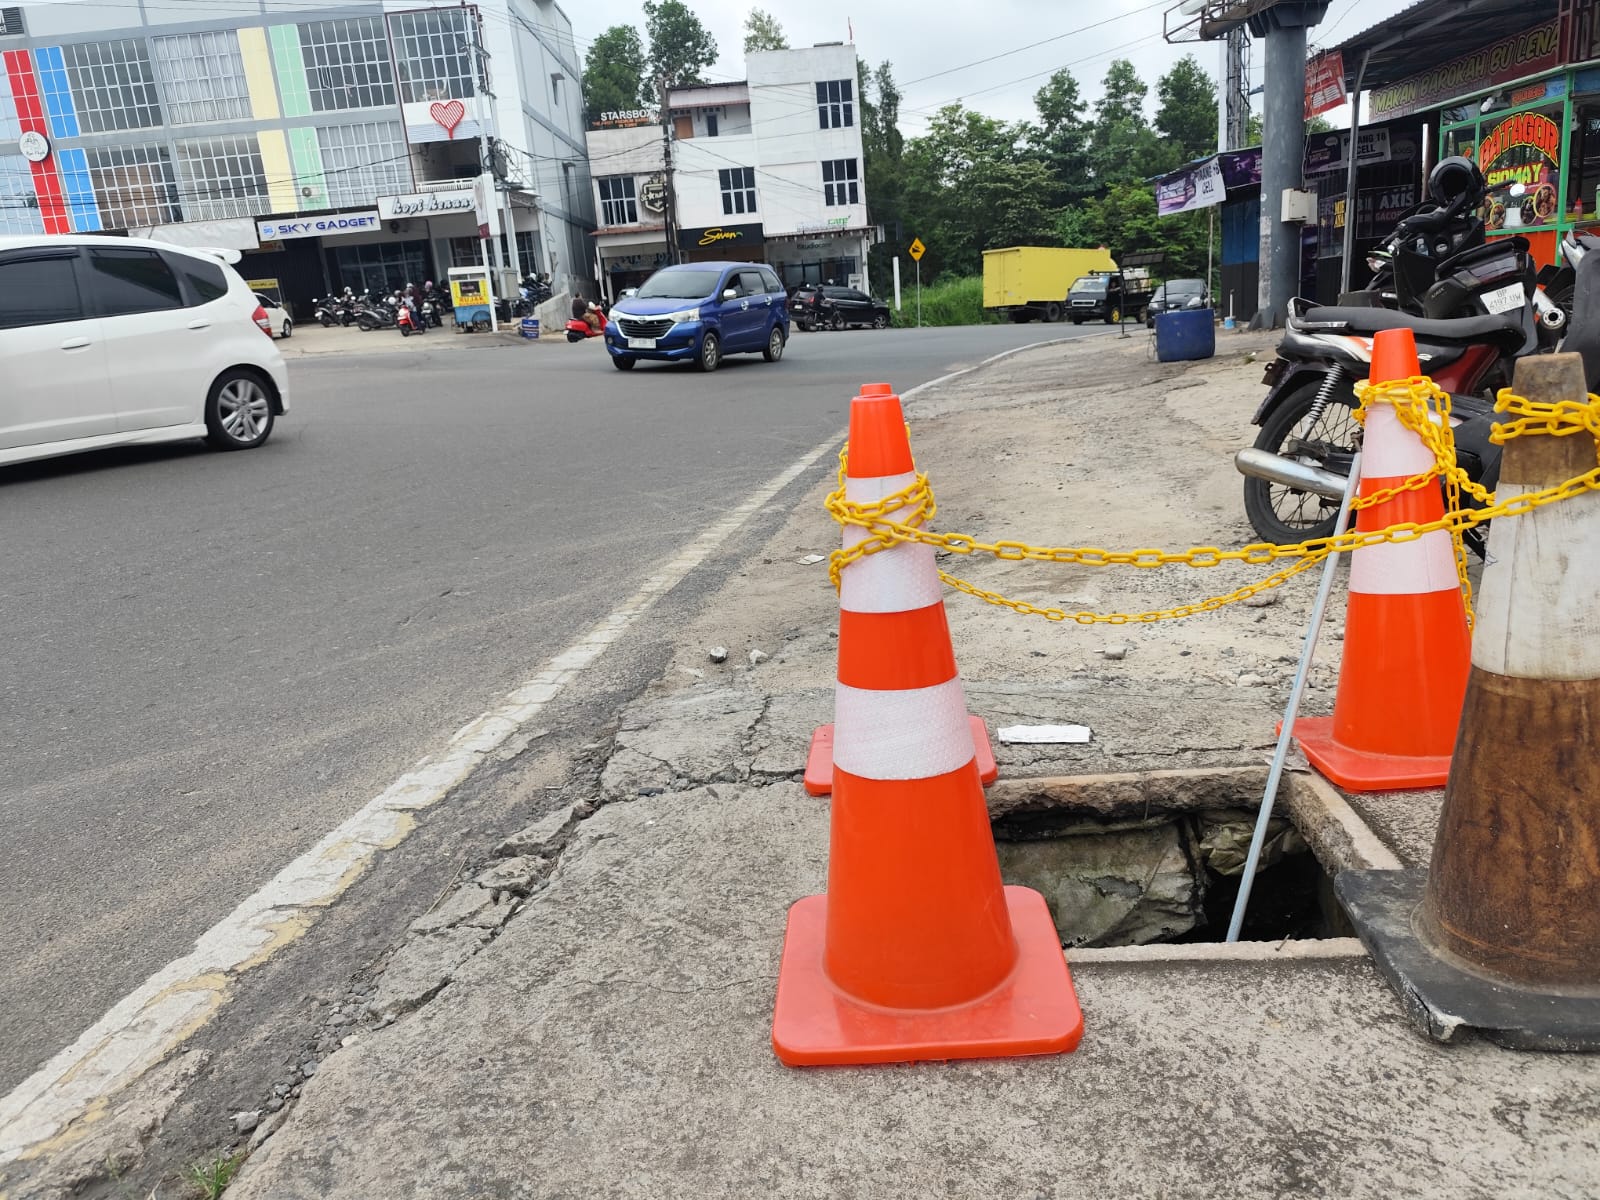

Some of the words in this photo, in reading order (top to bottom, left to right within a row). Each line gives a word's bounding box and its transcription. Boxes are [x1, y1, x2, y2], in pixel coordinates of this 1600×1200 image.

[1374, 81, 1417, 114] MAKAN
[1420, 52, 1488, 97] BAROKAH
[1490, 43, 1513, 73] BU
[1478, 112, 1559, 175] BATAGOR
[1487, 163, 1543, 186] SIOMAY
[393, 196, 424, 215] kopi
[1379, 191, 1415, 210] AXIS
[278, 223, 312, 235] SKY
[315, 217, 376, 231] GADGET
